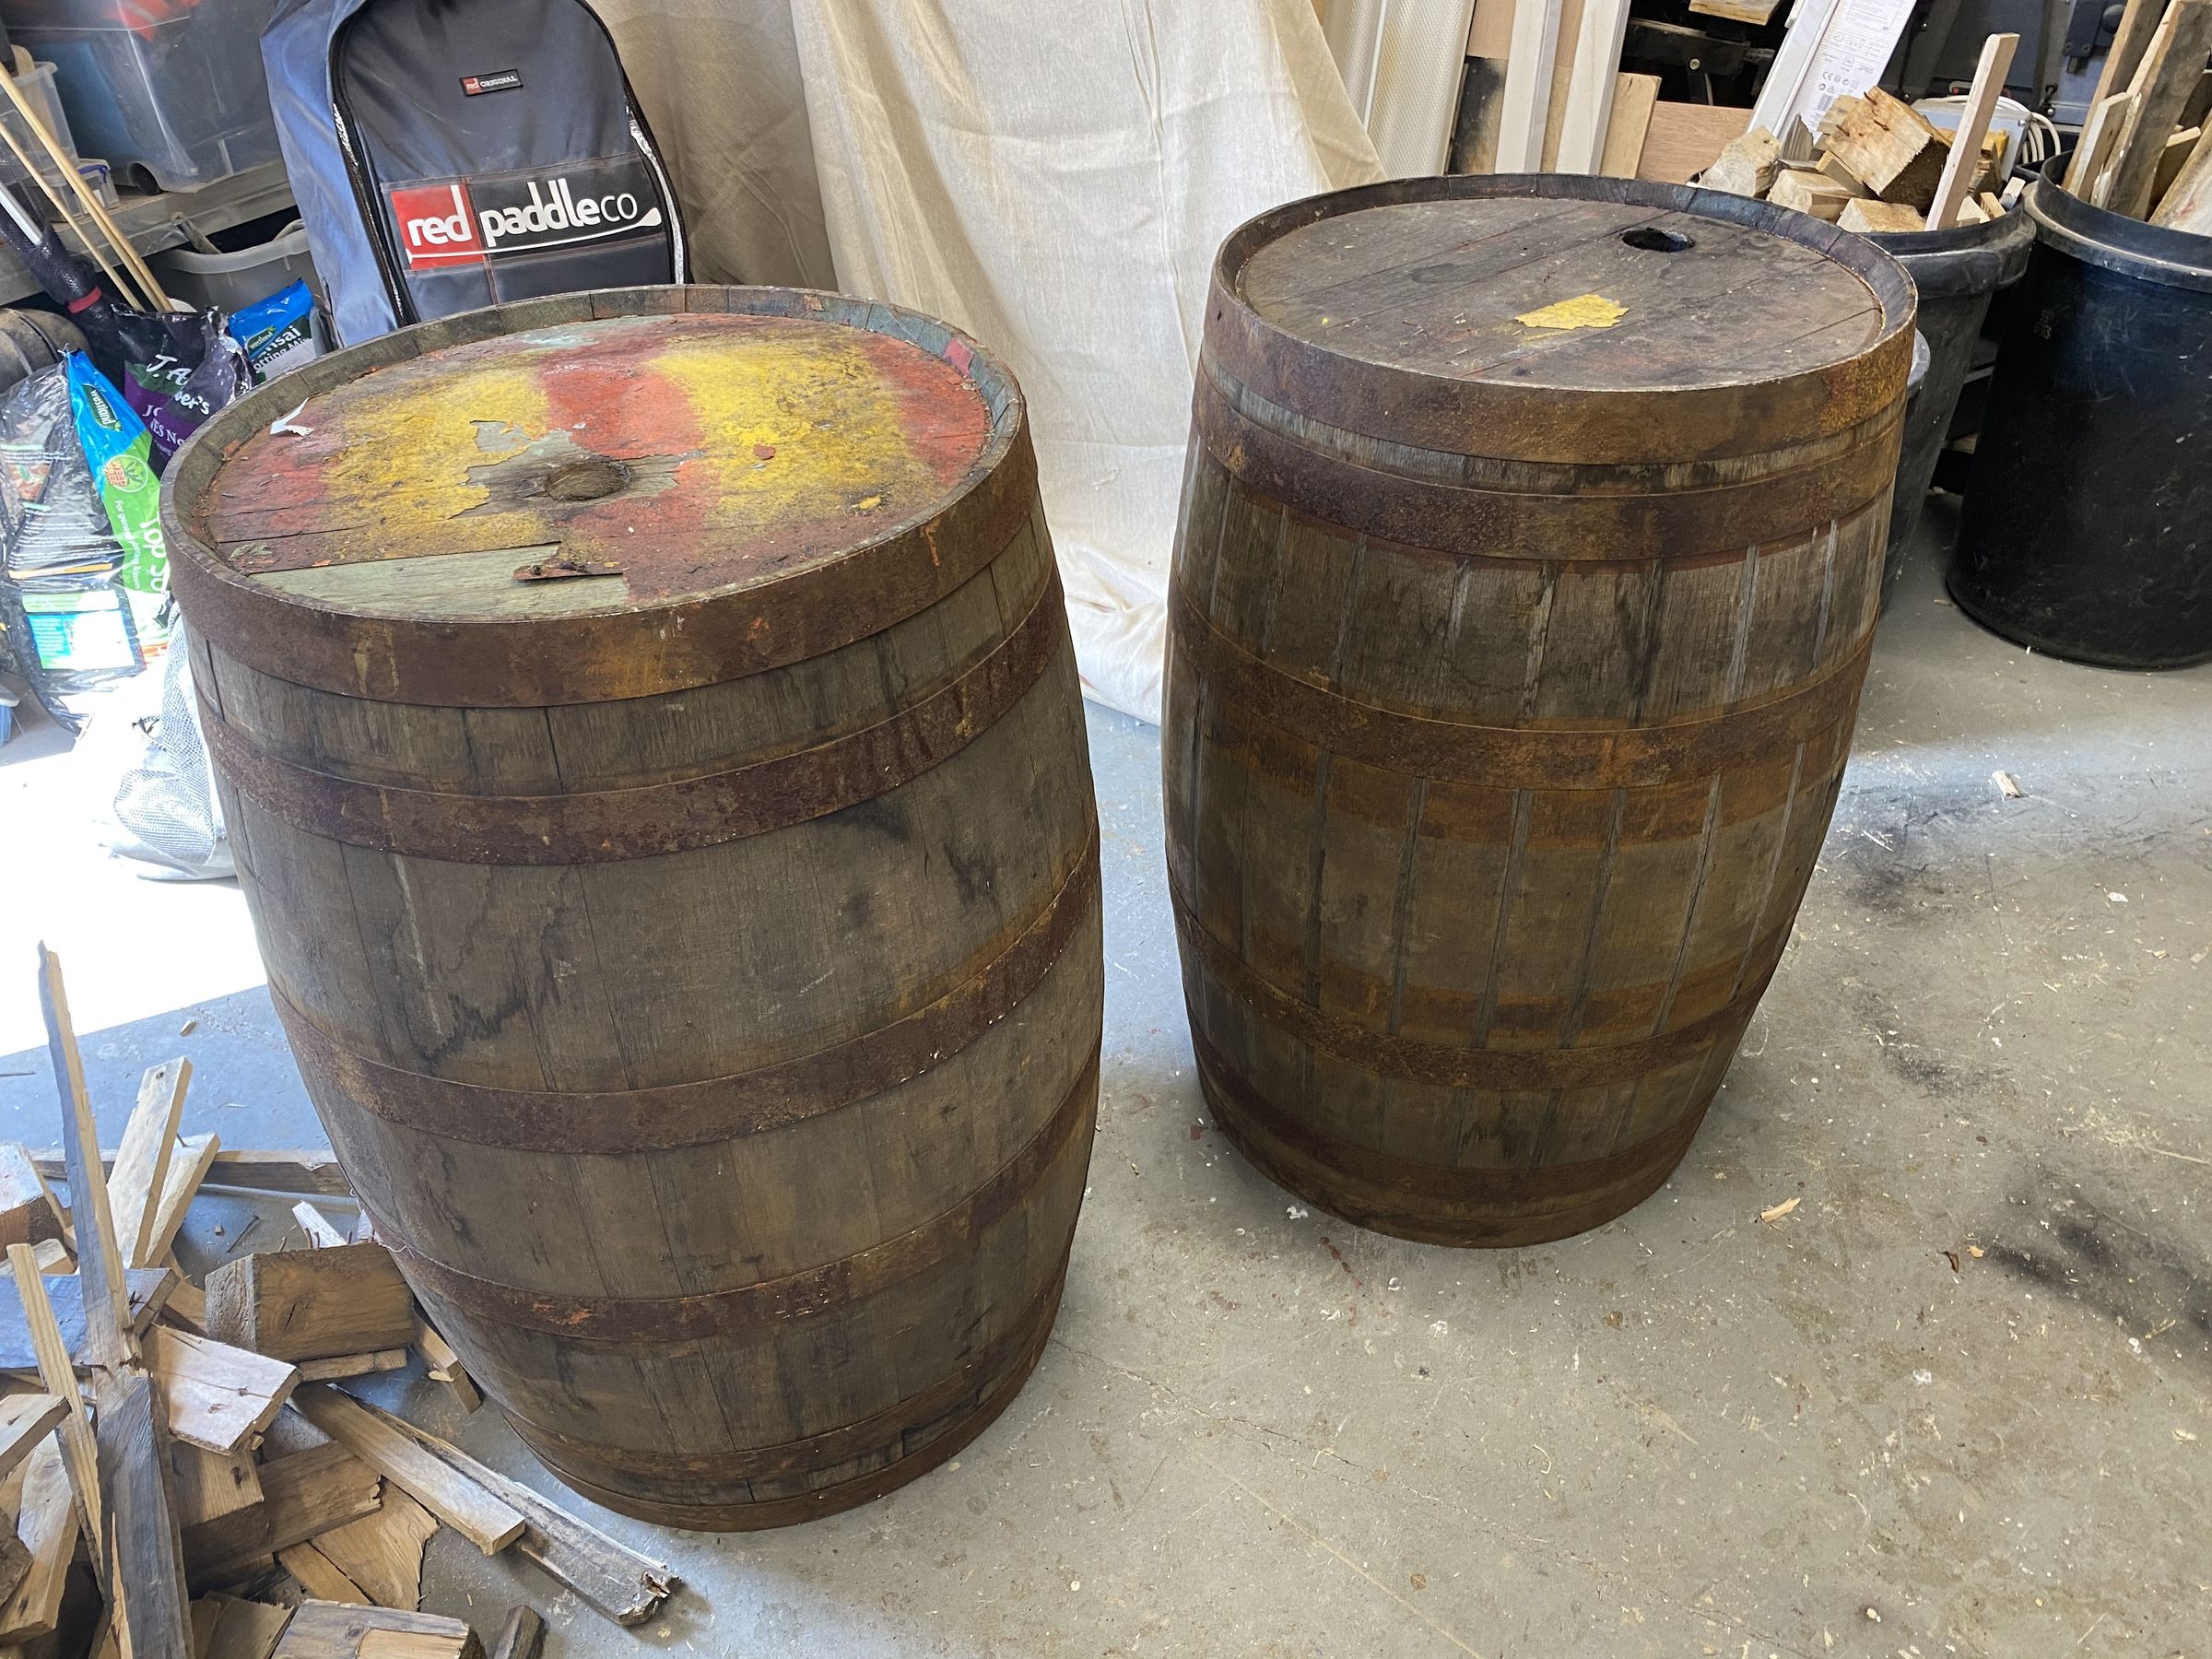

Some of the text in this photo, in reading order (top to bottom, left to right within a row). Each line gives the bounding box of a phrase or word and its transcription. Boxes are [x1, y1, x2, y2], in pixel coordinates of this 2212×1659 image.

[465, 76, 518, 89] red ORIGINAL
[406, 184, 473, 246] red
[258, 324, 301, 358] nsai
[253, 348, 286, 372] otting
[90, 388, 116, 425] westland
[114, 500, 124, 513] For
